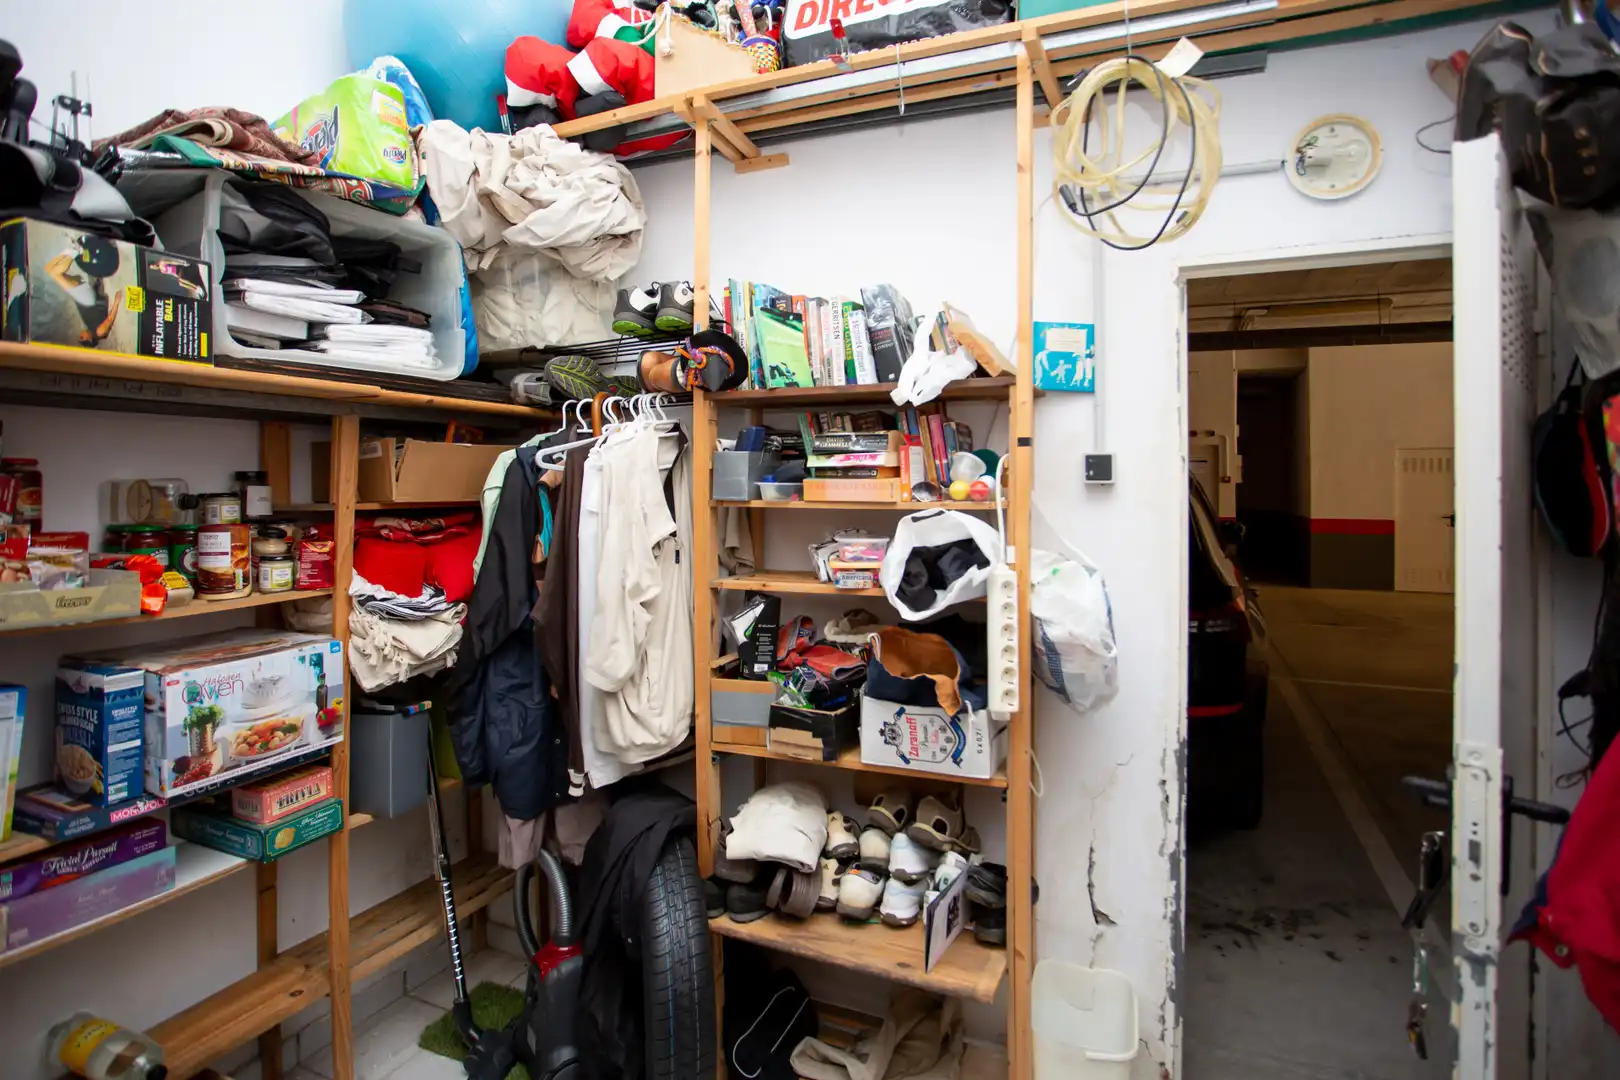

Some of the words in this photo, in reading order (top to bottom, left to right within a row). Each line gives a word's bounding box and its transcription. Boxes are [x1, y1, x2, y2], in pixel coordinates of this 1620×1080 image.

[383, 147, 406, 161] Plenty
[164, 297, 173, 322] BALL
[831, 301, 840, 340] GERRITSEN
[155, 299, 164, 354] INFLATABLE
[844, 331, 853, 361] GAMES
[181, 678, 244, 704] Oven
[204, 672, 242, 686] Halogen
[76, 706, 98, 723] STYLE
[905, 716, 920, 758] Zaranoff
[41, 852, 82, 876] Trivial
[83, 840, 118, 870] Pursuit
